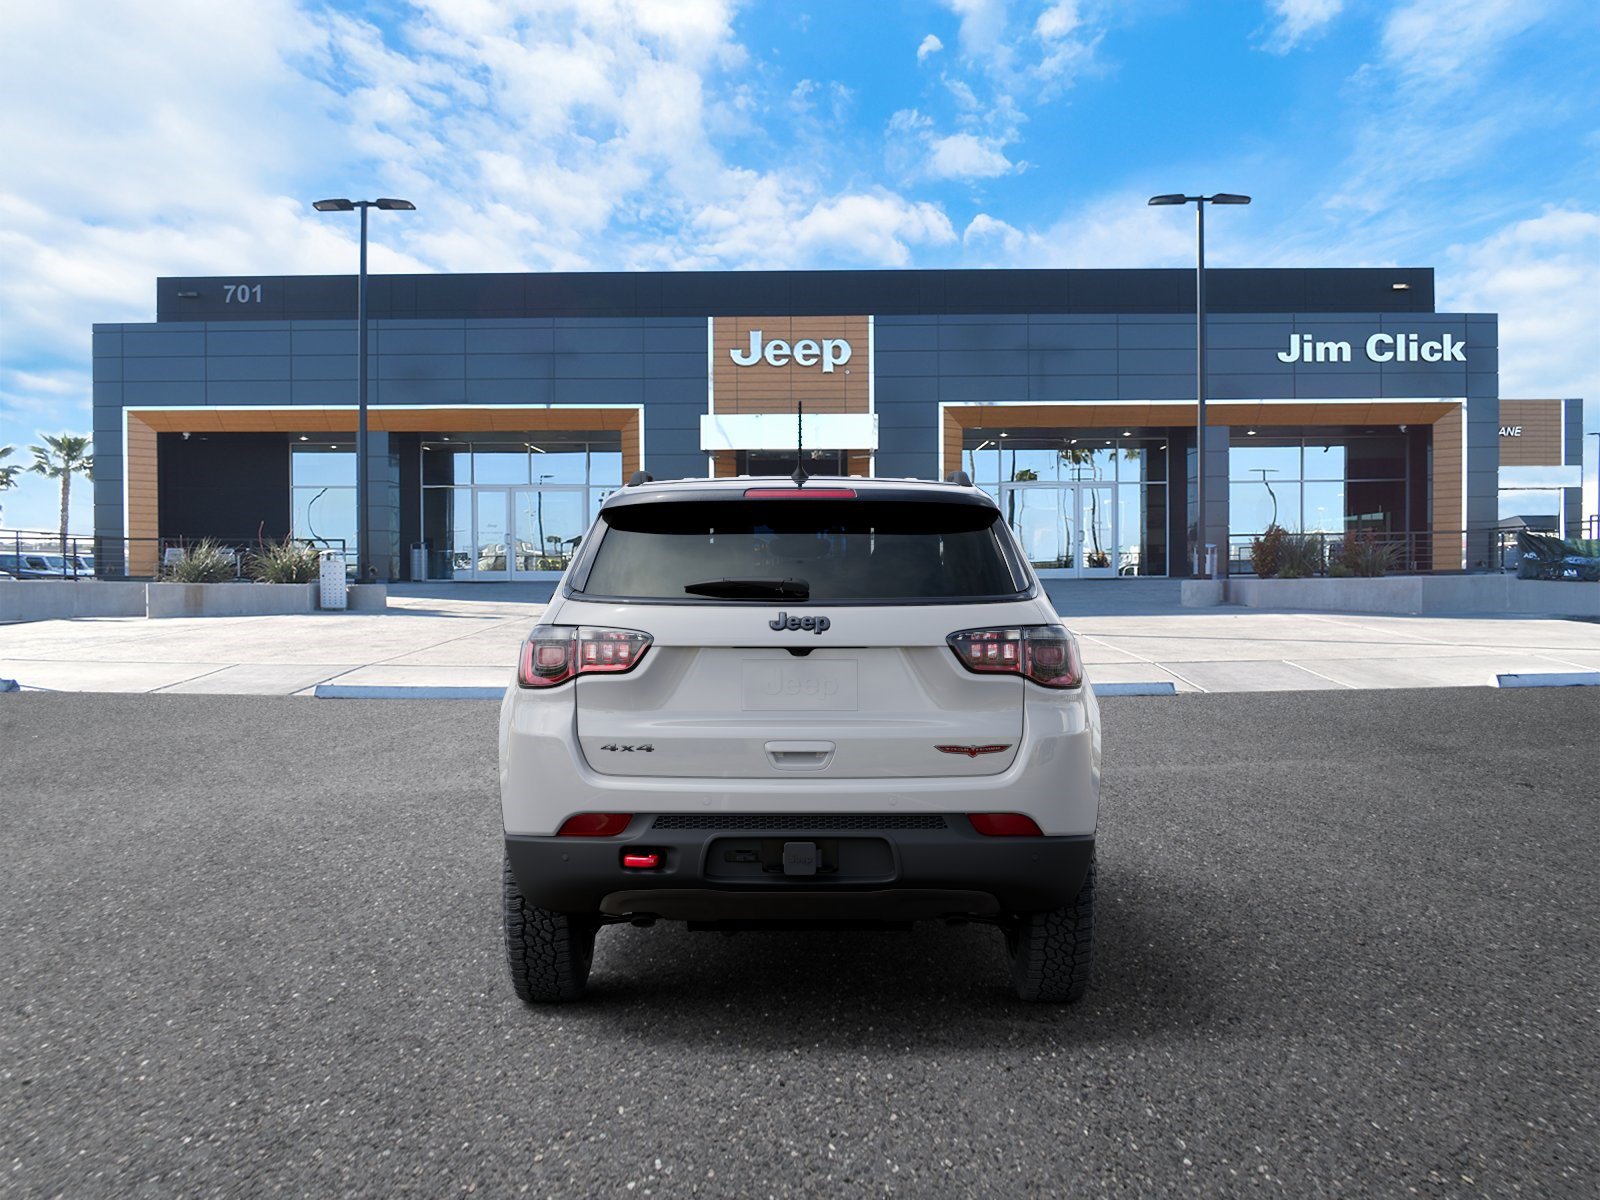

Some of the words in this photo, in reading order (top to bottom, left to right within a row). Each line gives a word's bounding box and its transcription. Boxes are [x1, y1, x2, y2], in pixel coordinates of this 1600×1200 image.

[223, 284, 262, 304] 701
[729, 330, 852, 373] Jeep
[1277, 333, 1352, 363] Jim
[1365, 333, 1467, 363] Click
[769, 612, 831, 635] Jeep
[764, 667, 839, 701] Jeep
